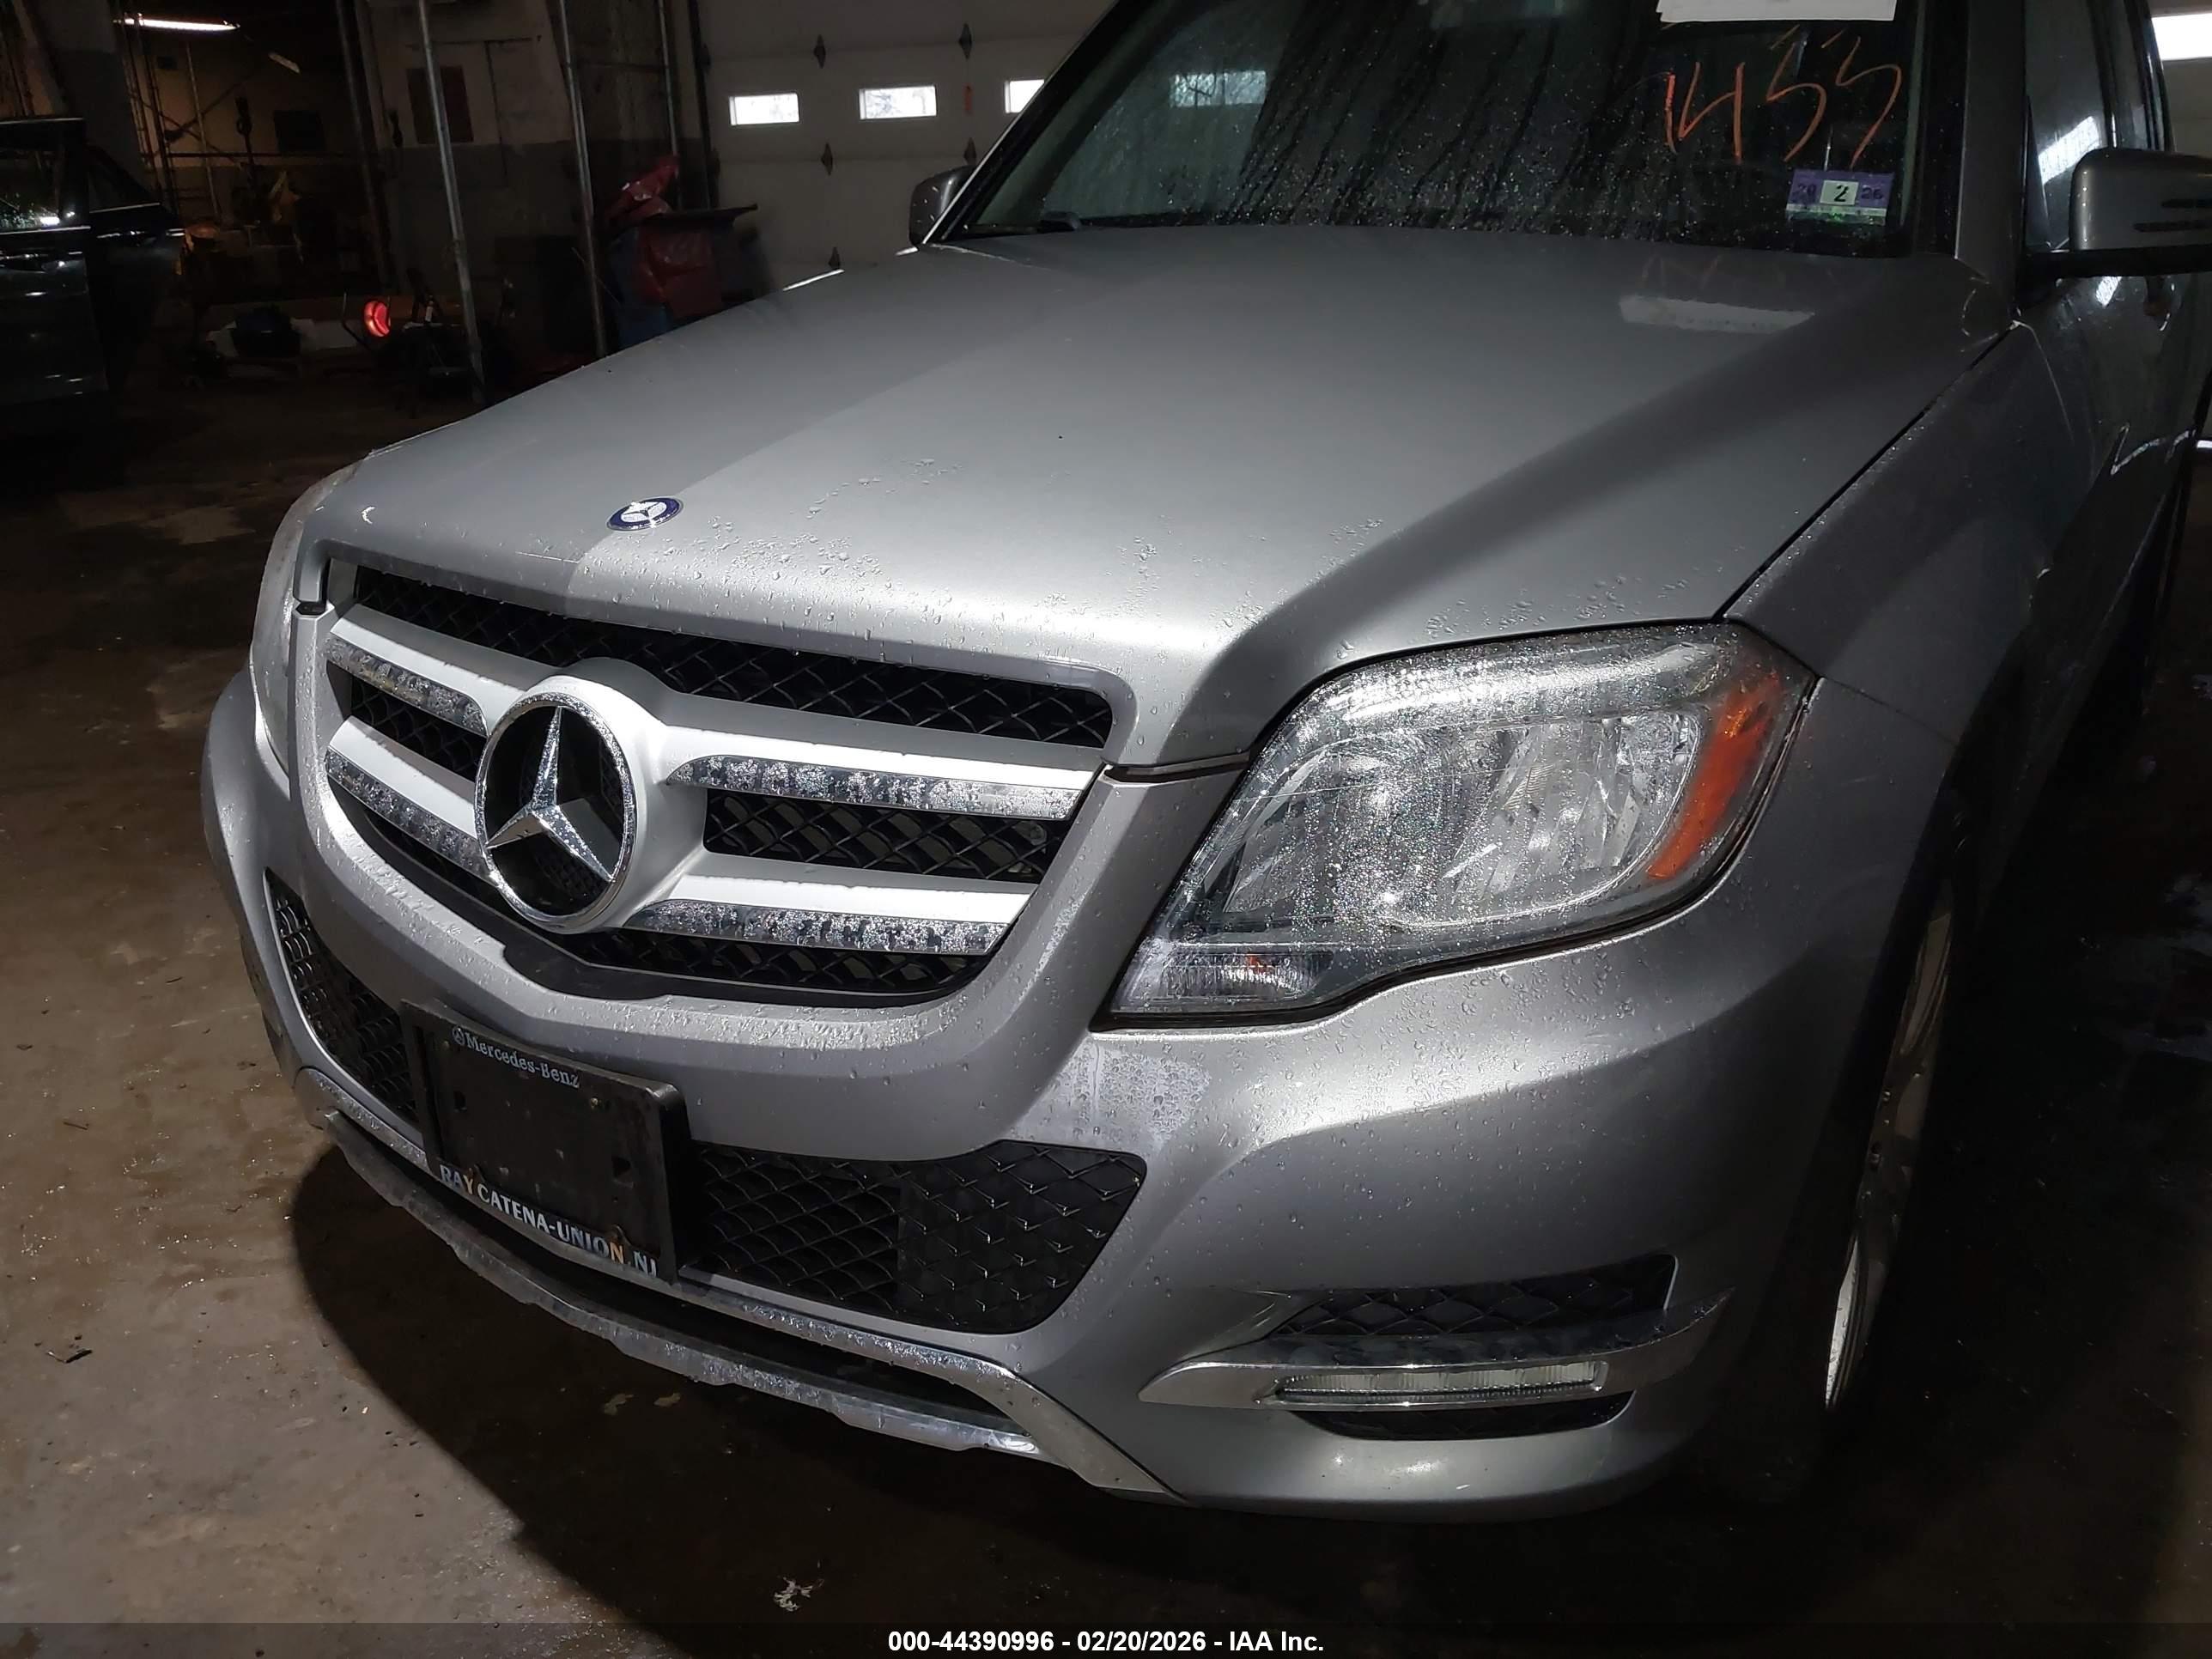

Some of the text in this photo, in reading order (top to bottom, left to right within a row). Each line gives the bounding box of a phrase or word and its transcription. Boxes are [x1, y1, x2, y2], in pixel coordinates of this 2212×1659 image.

[1833, 185, 1849, 202] 2
[1861, 186, 1883, 200] 26
[464, 1030, 580, 1090] Mercedes-Benz
[439, 1164, 473, 1195] RAY
[632, 1250, 658, 1278] NJ
